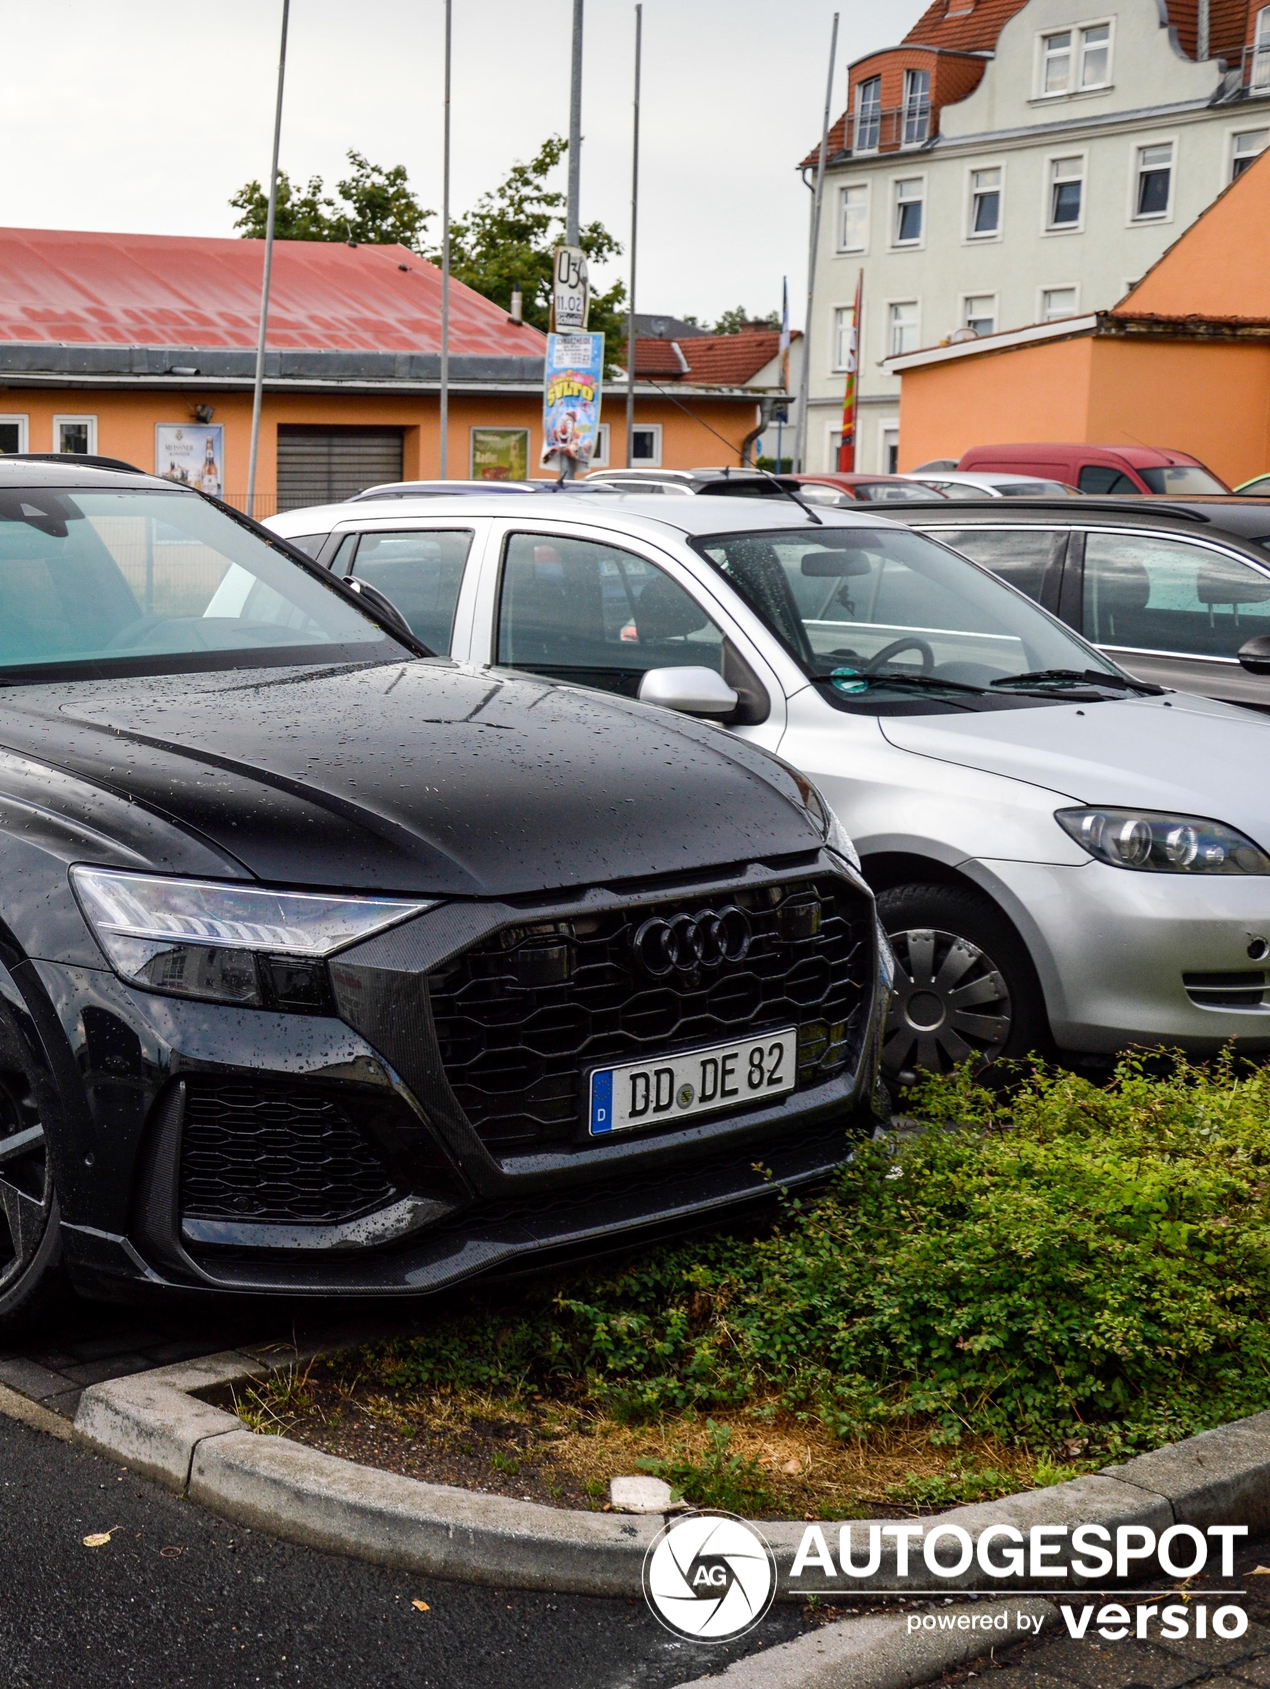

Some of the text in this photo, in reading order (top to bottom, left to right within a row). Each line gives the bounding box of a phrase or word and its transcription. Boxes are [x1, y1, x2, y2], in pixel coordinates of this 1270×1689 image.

[628, 1041, 784, 1119] DD DE 82
[597, 1108, 606, 1122] D
